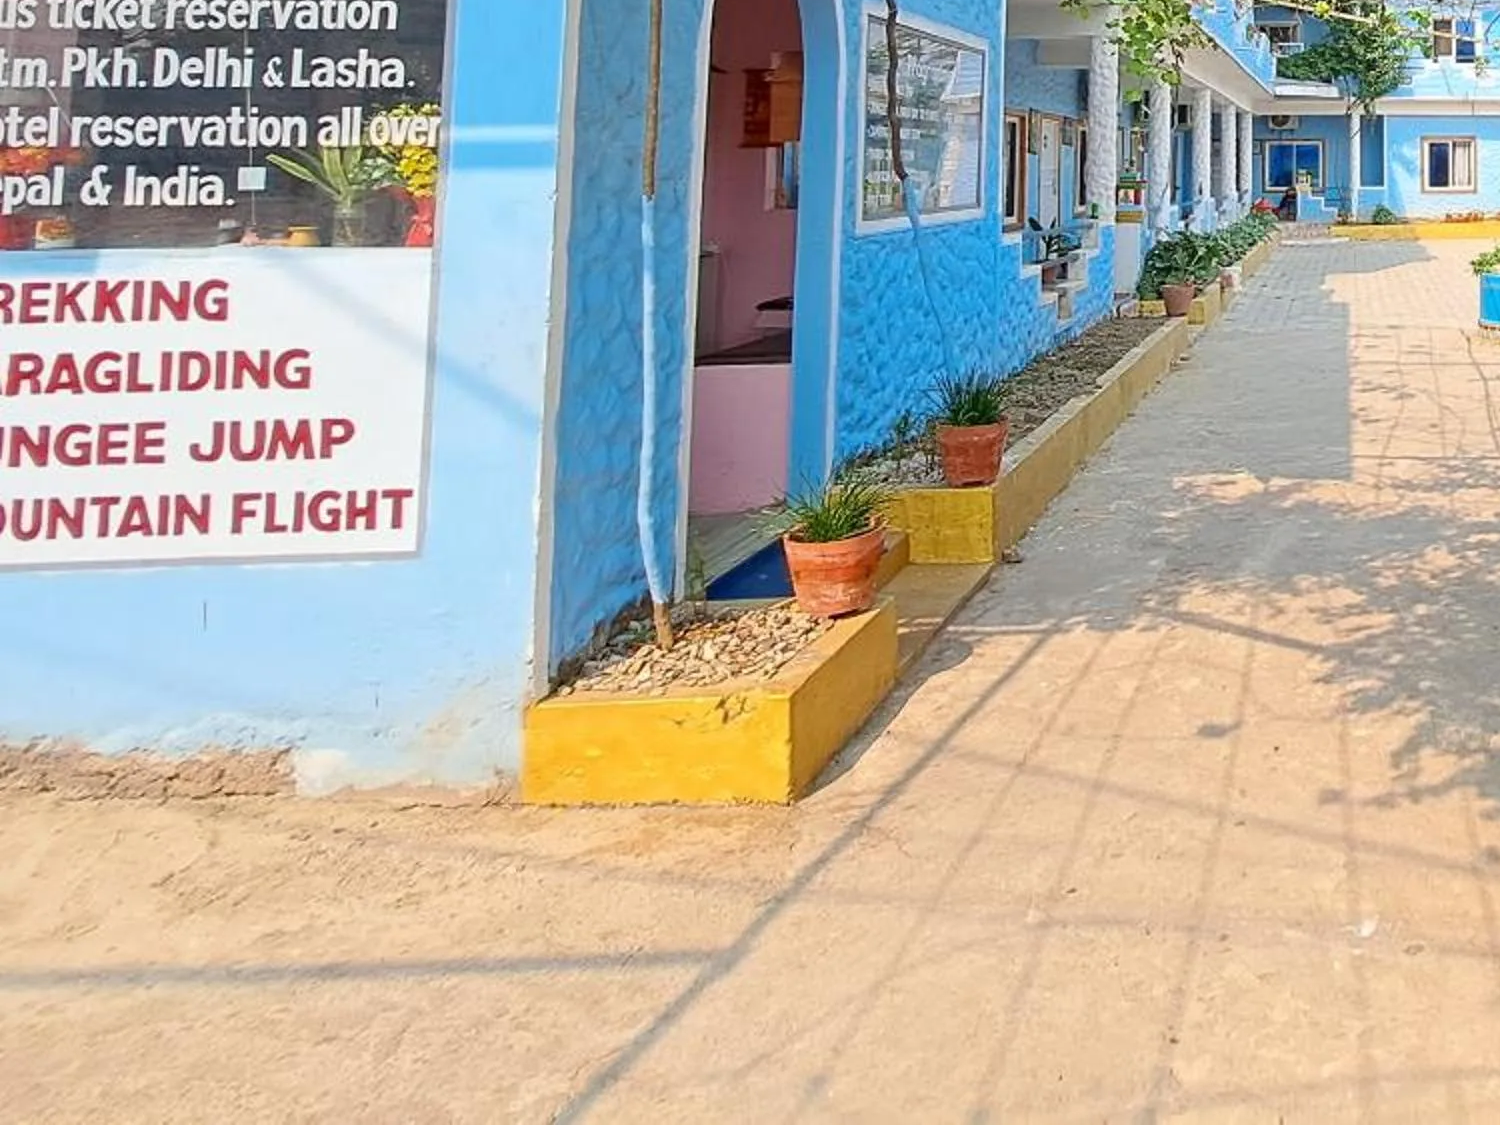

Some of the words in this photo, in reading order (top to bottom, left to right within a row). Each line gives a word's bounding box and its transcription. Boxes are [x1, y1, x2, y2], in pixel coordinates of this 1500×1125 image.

[61, 47, 147, 89] Pkh.
[153, 47, 253, 89] Delhi
[262, 58, 284, 89] &
[291, 48, 416, 89] Lasha.
[0, 105, 60, 149] tel
[70, 106, 308, 149] reservation
[317, 106, 361, 148] all
[368, 115, 442, 149] over
[0, 165, 65, 214] pal
[80, 165, 112, 207] &
[123, 165, 236, 207] India.
[0, 348, 312, 397] RAGLIDING
[0, 421, 167, 468] NGEE
[189, 418, 356, 463] JUMP
[0, 493, 211, 542] UNTAIN
[230, 488, 414, 535] FLIGHT
